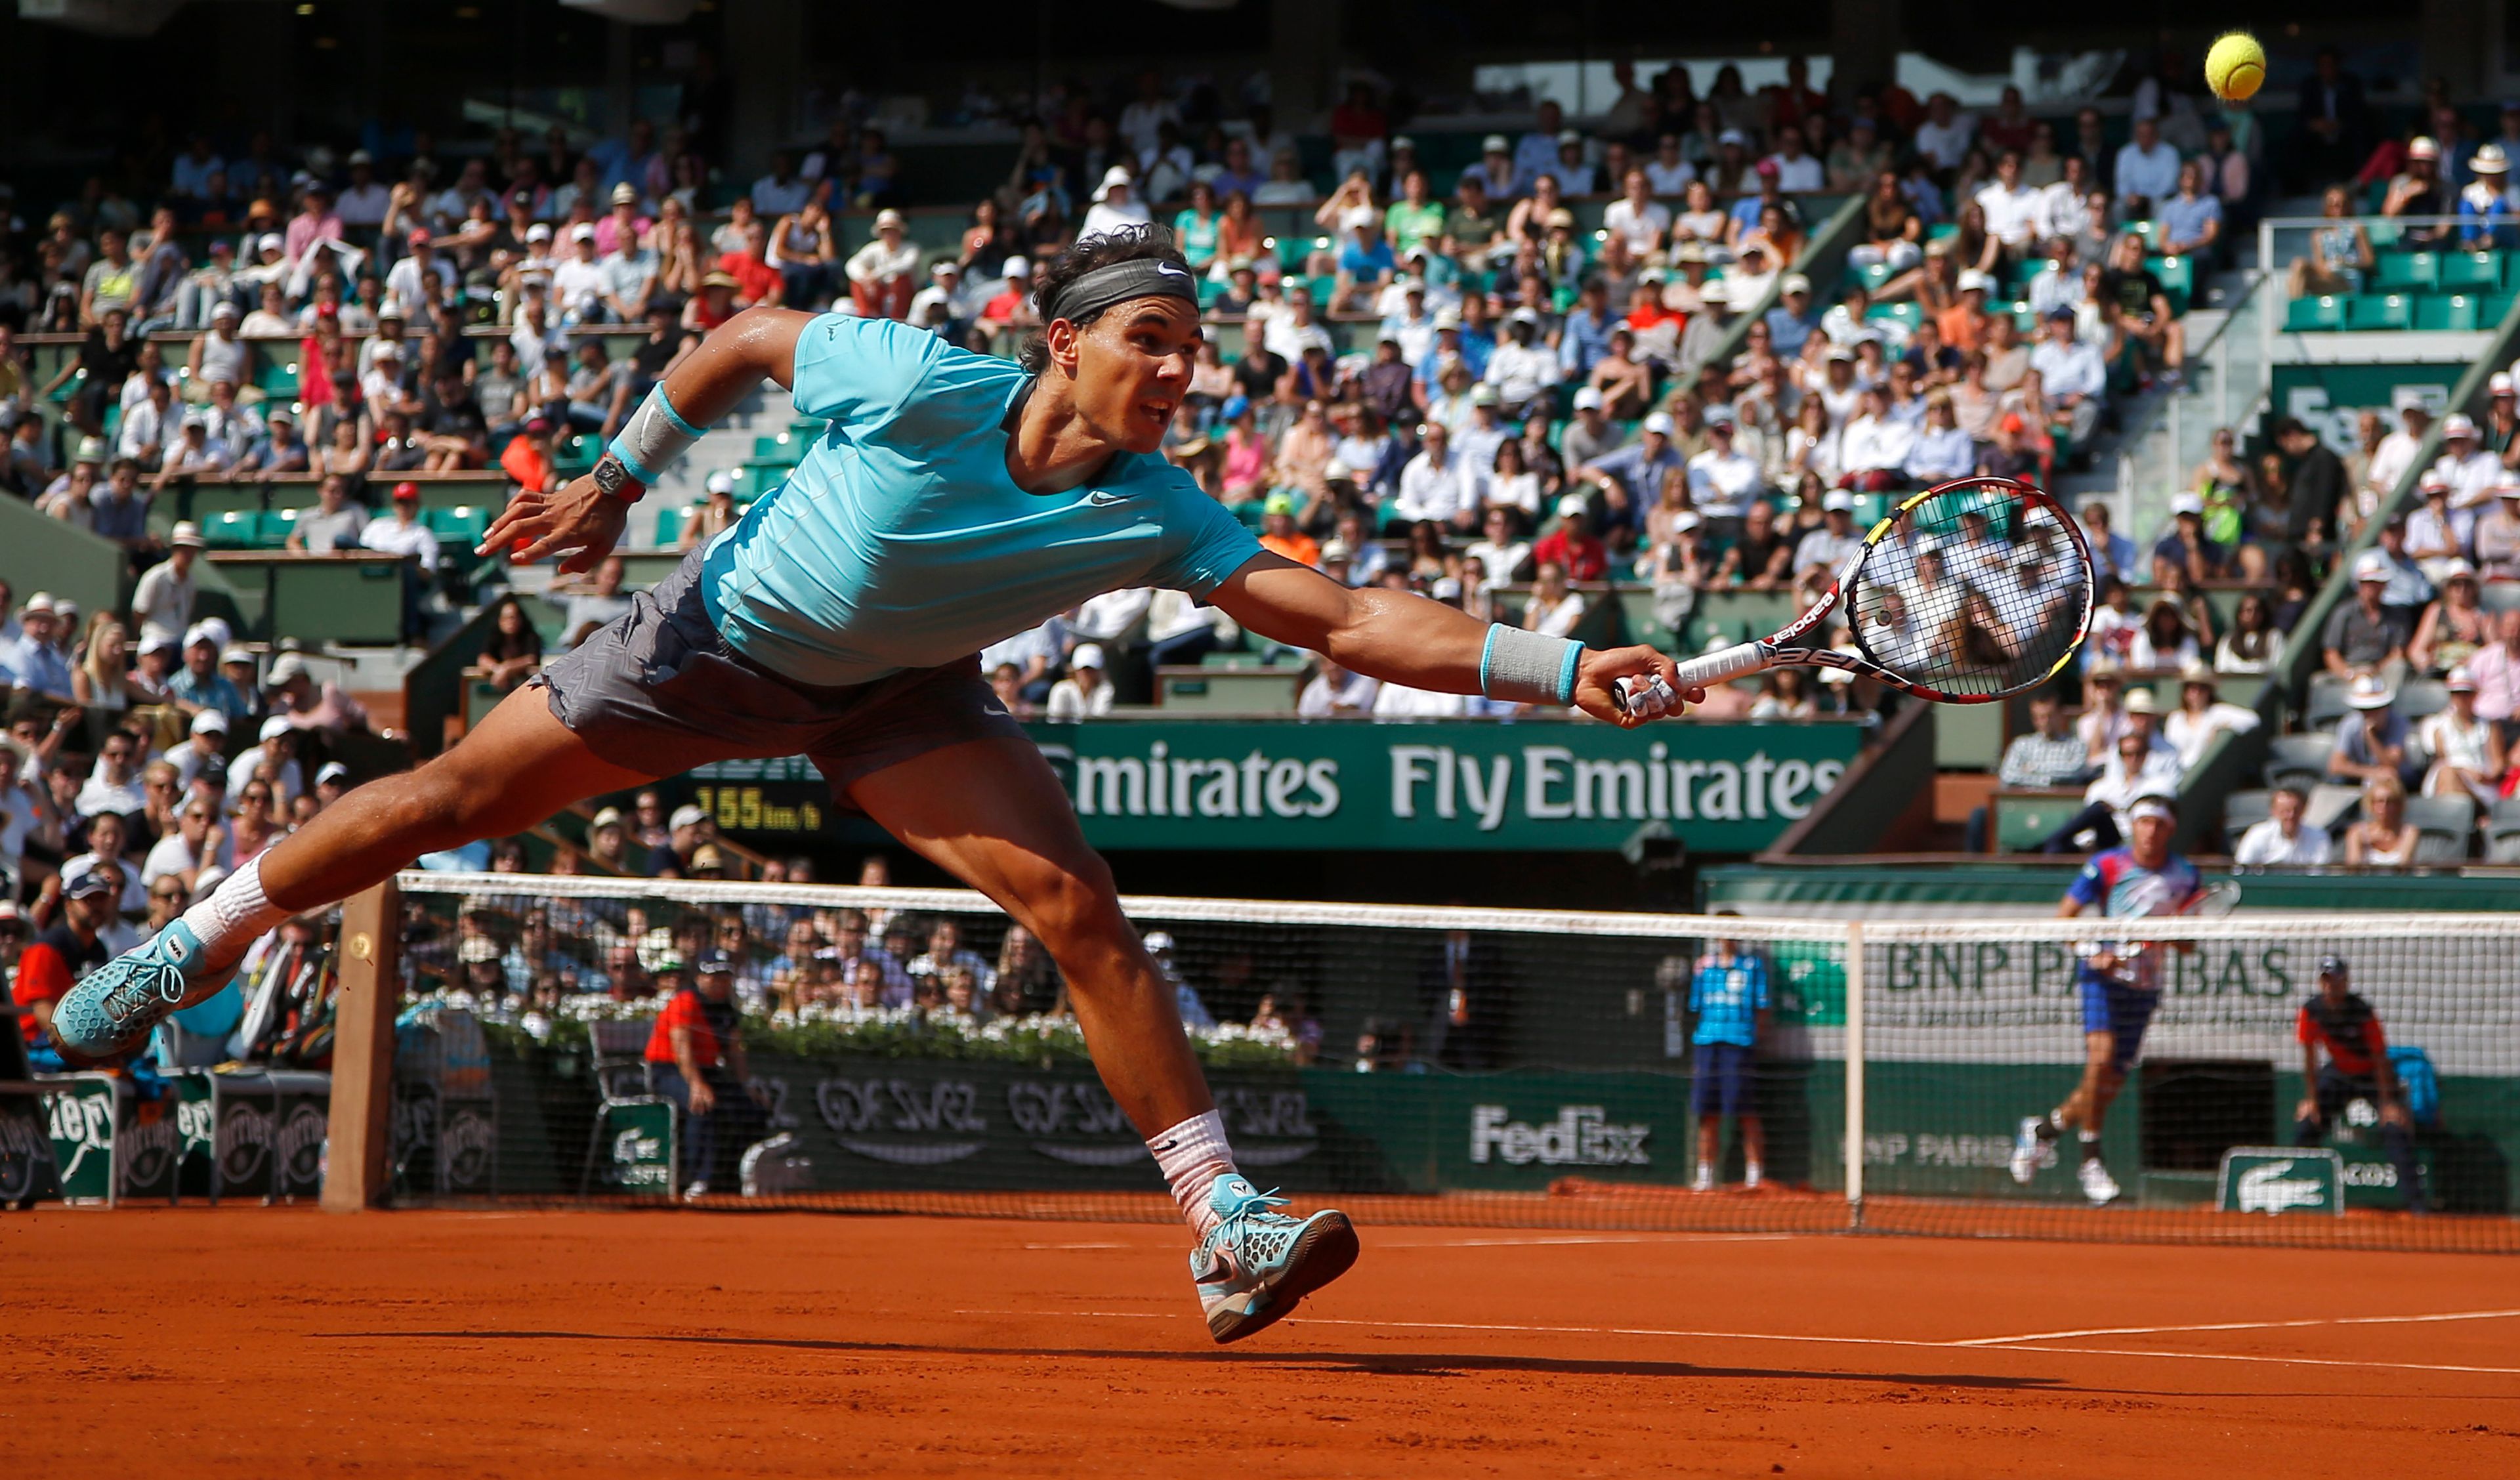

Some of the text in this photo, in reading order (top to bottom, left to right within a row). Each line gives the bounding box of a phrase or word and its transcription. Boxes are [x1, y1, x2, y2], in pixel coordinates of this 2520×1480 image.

[1772, 592, 1836, 645] Babolat
[1389, 744, 1511, 831] Fly
[1522, 742, 1845, 820] Emirates
[1886, 942, 2010, 990] BNP
[1470, 1104, 1651, 1166] FedEx
[1840, 1132, 2060, 1170] NP PARIBS
